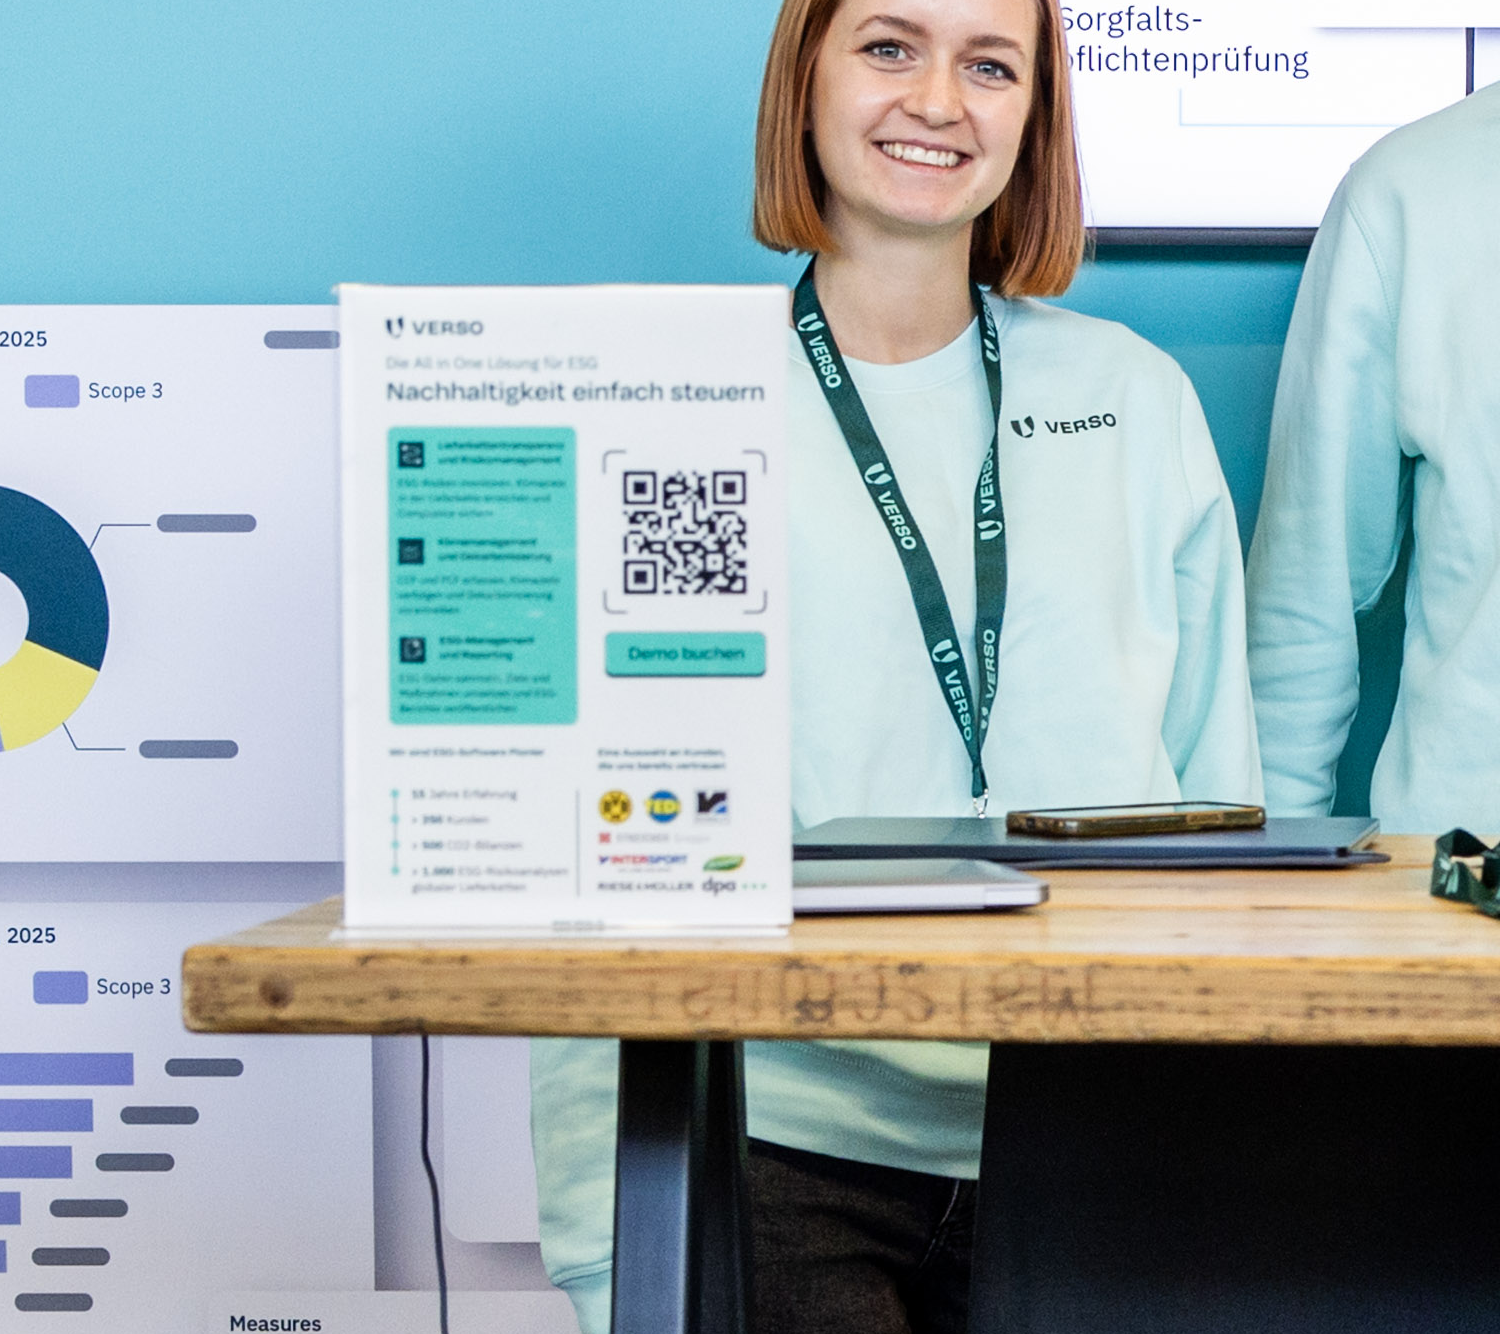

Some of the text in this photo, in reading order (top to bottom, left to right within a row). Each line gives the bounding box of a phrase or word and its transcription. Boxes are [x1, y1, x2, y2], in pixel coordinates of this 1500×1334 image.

[1061, 6, 1202, 38] Sorgfalts-
[413, 321, 483, 335] VERSO
[0, 331, 47, 347] 2025
[386, 356, 598, 373] Die All in One Lösung für ESG
[808, 334, 842, 389] VERSO
[89, 382, 162, 402] Scope 3
[387, 382, 764, 405] Nachhaltigkeit einfach steuern
[1045, 413, 1116, 433] VERSO
[876, 490, 917, 551] VERSO
[628, 646, 745, 660] Demo buchen
[982, 628, 996, 699] VERSO
[944, 670, 973, 742] VERSO
[702, 877, 736, 896] dpa
[8, 927, 55, 943] 2025
[97, 978, 170, 999] Scope 3
[231, 1316, 321, 1331] Measures
